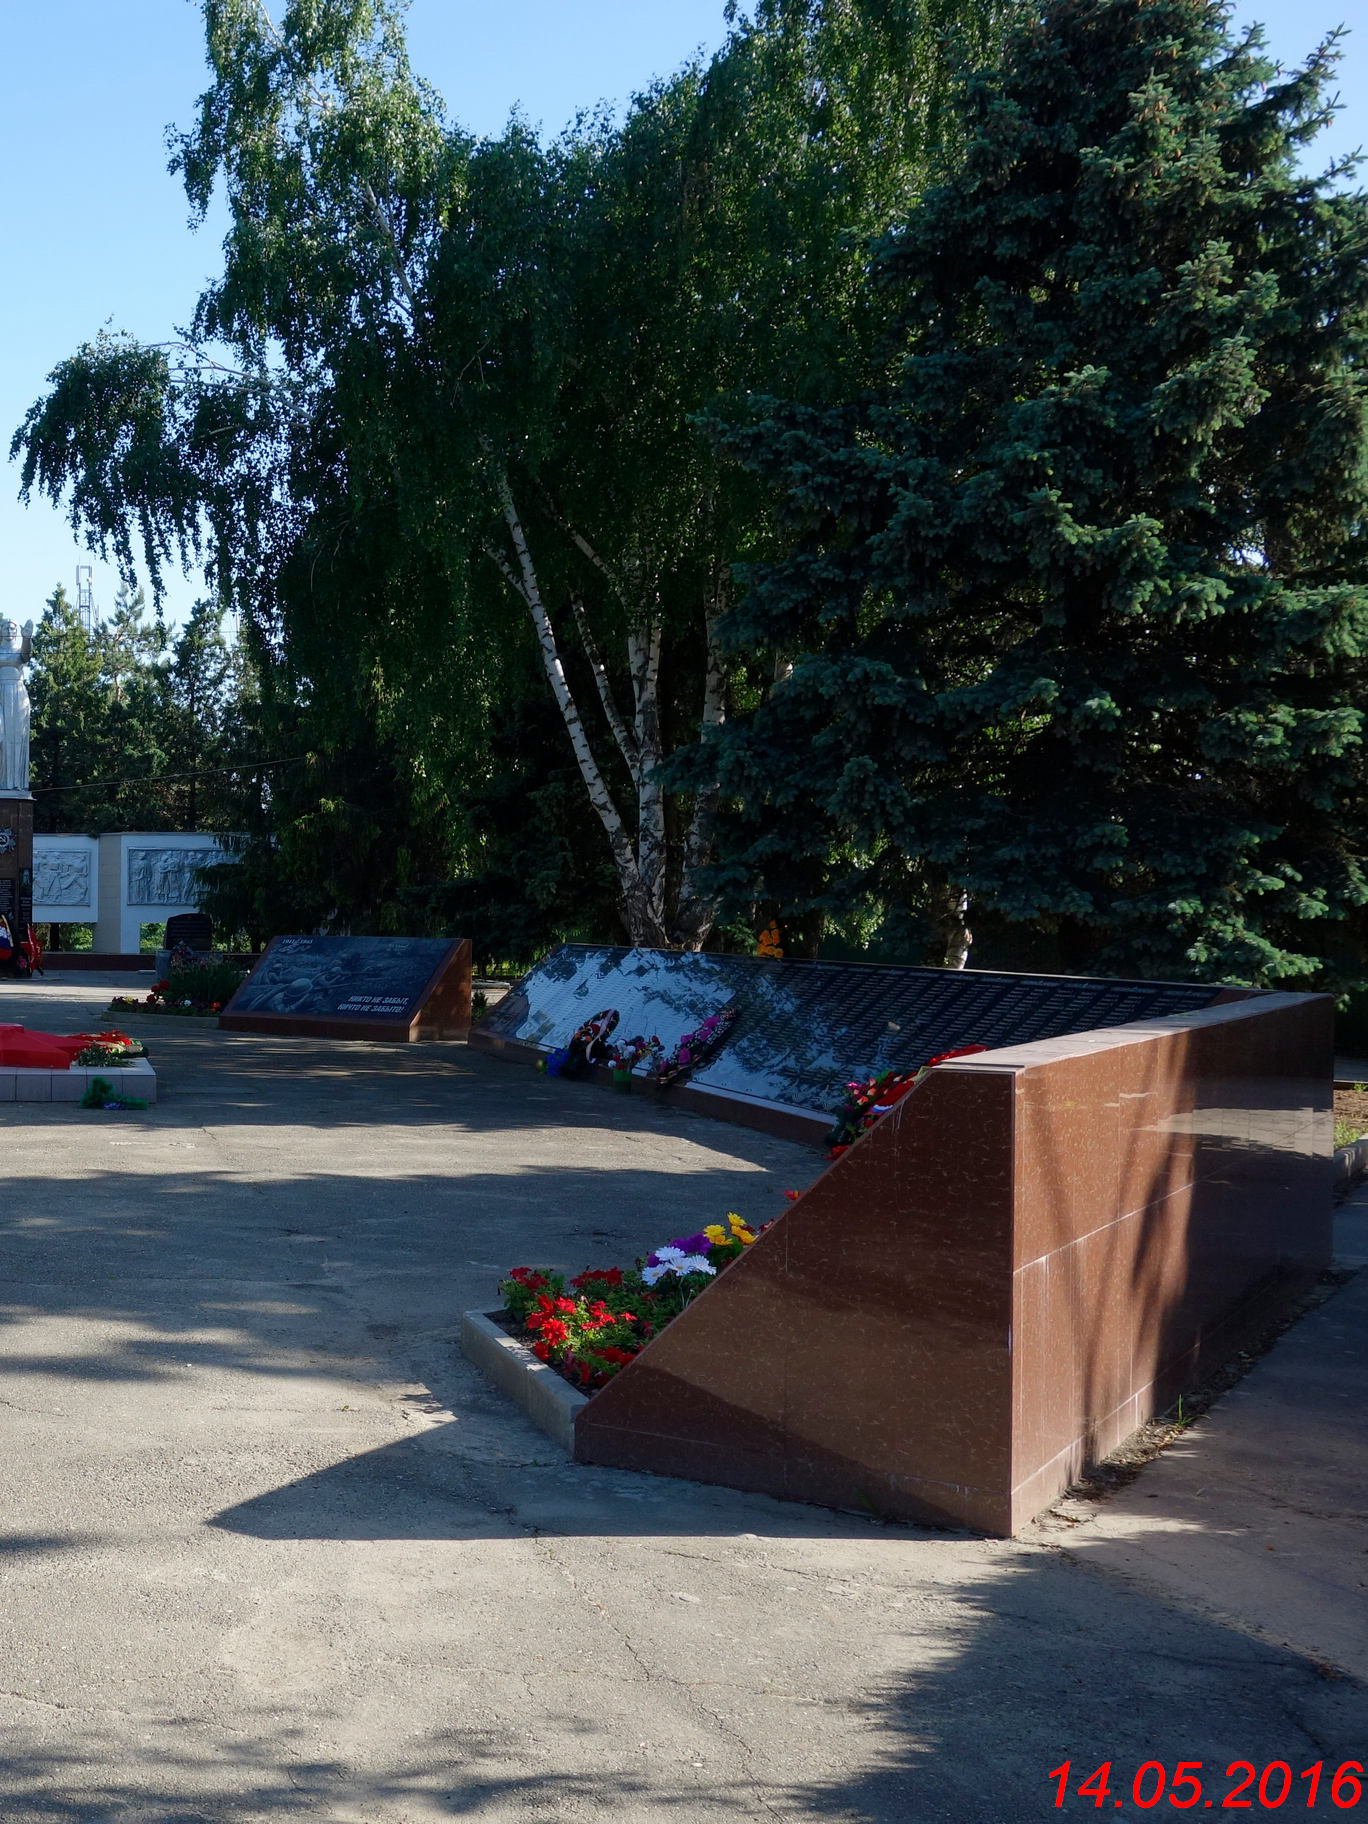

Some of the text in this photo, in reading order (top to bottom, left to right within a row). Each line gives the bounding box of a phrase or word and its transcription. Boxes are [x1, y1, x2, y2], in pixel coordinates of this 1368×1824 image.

[348, 995, 372, 1003] НИКТО
[382, 997, 409, 1005] ЗАБЫТ,
[337, 1003, 404, 1013] НИЧТО НЕ ЗАБЫТО!
